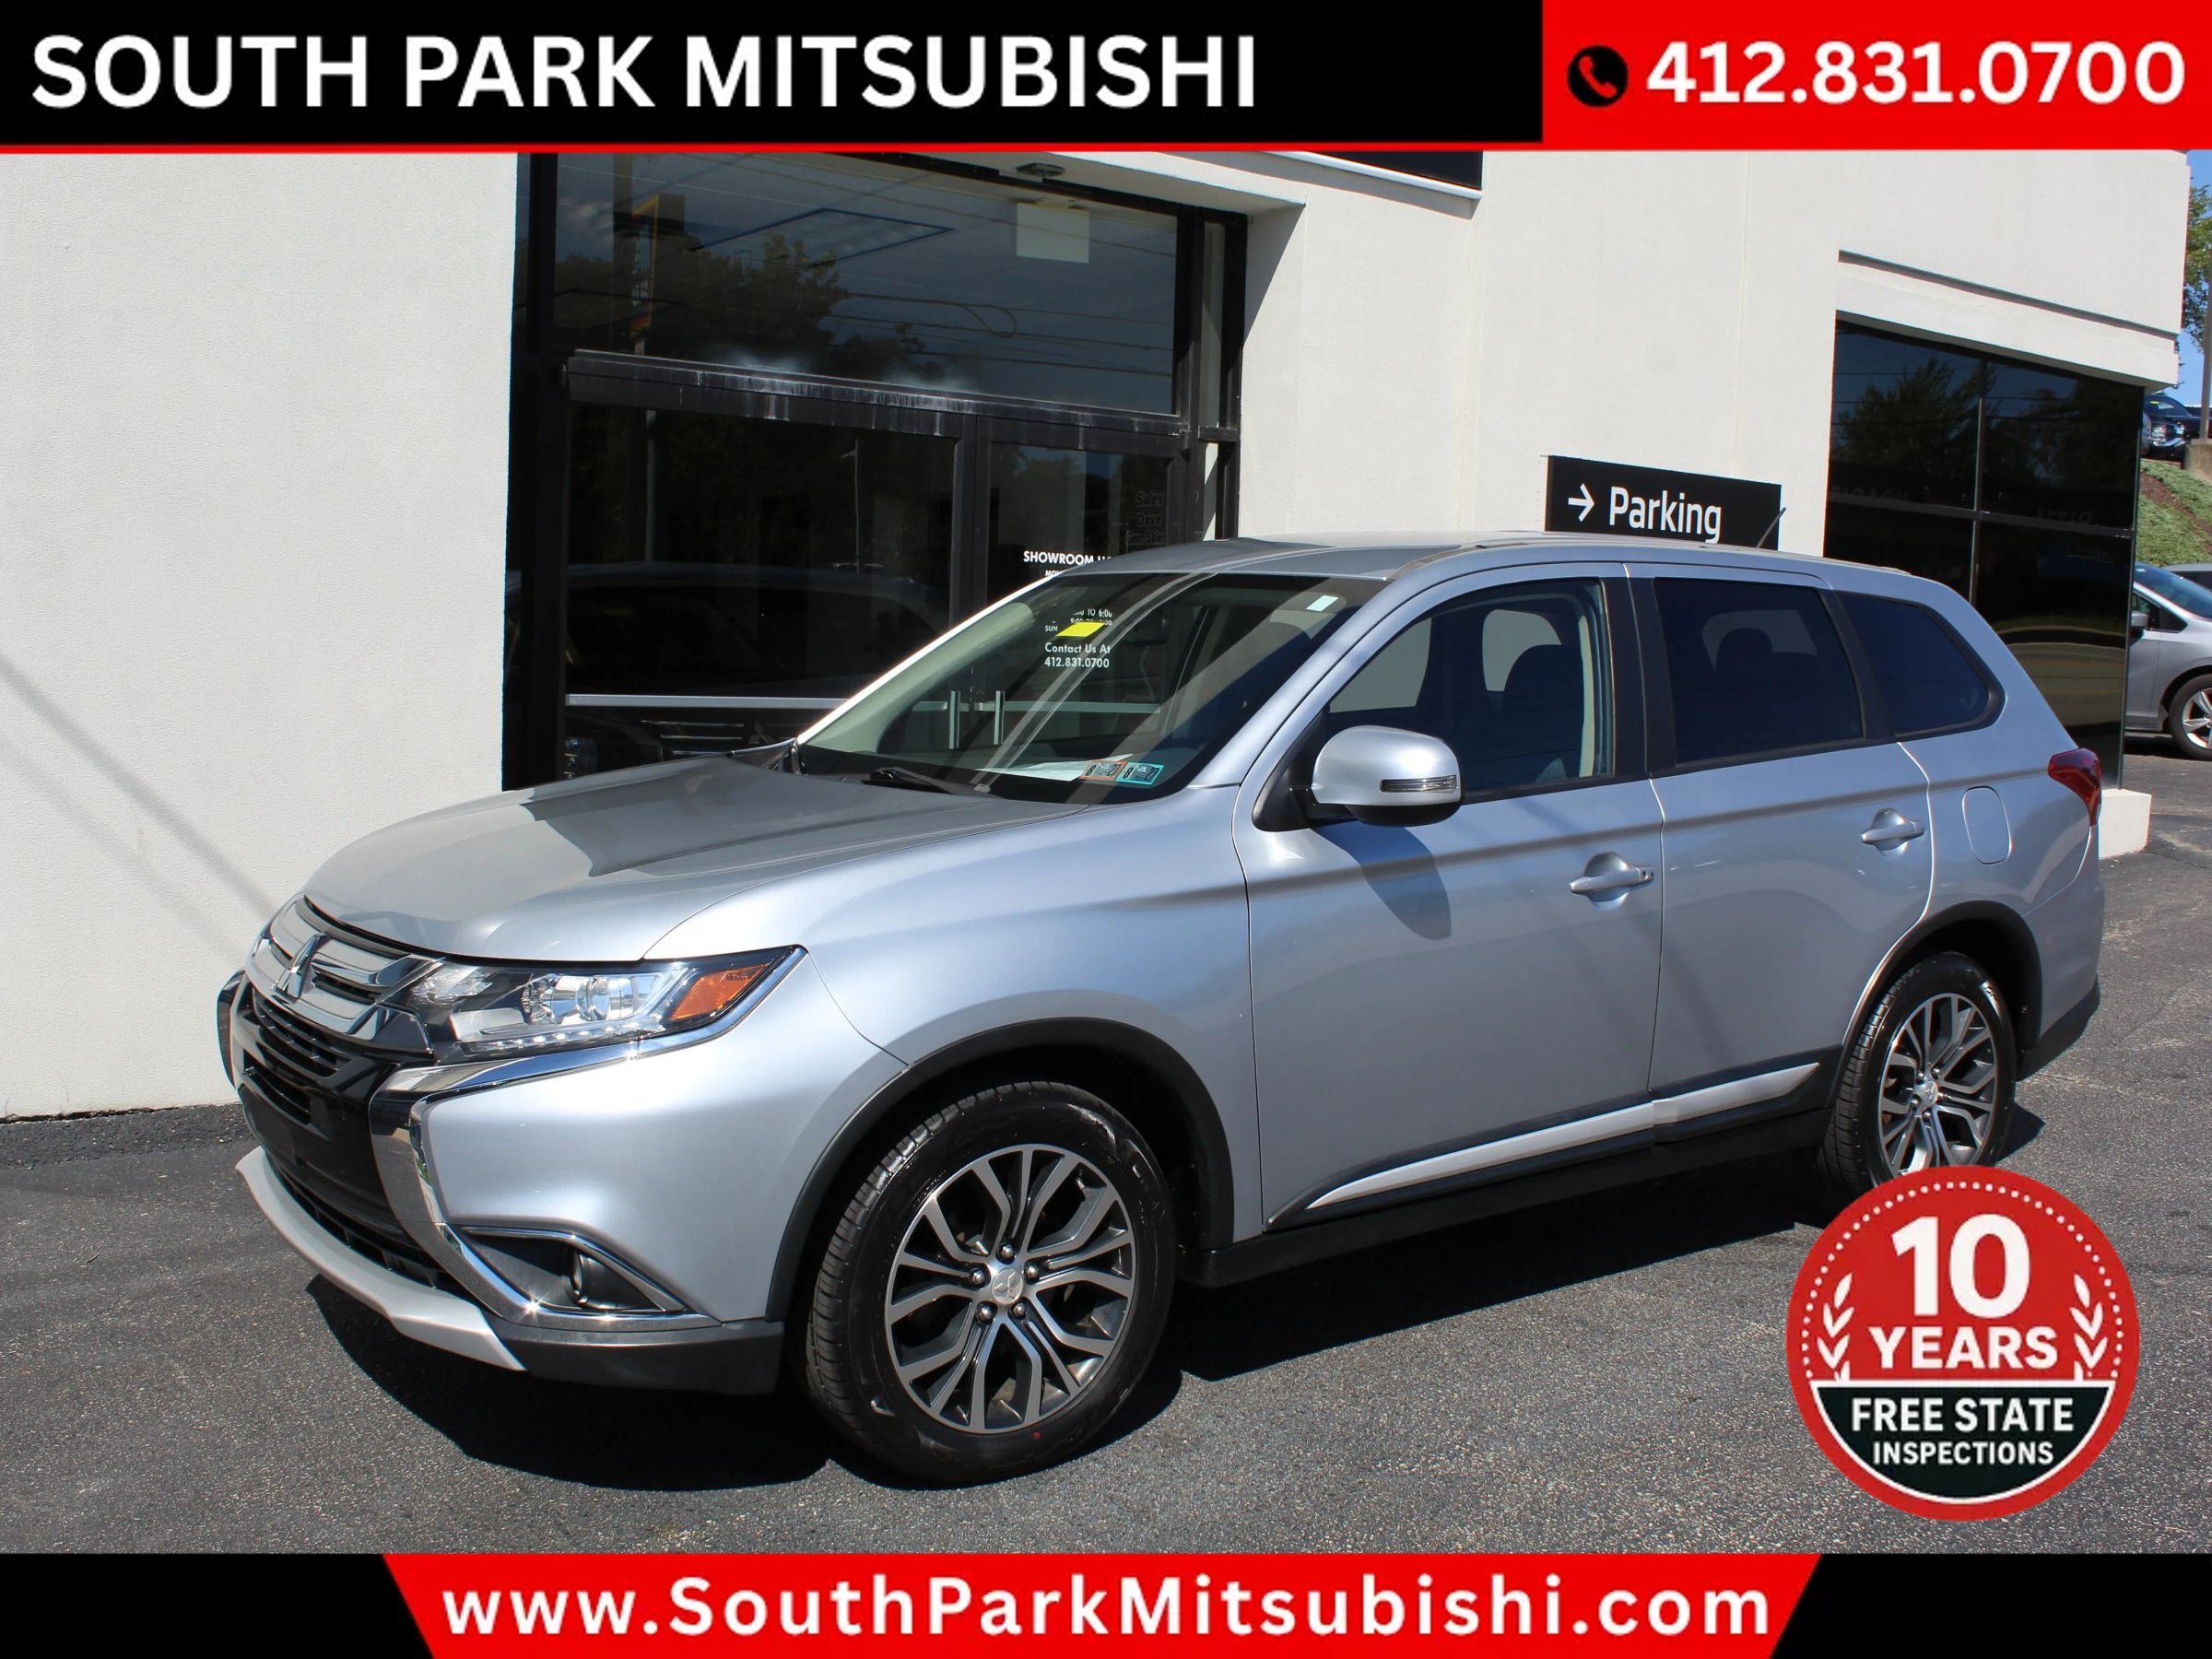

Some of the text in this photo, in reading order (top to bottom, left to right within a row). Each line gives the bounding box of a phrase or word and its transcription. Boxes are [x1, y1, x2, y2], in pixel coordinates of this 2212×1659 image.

[1608, 486, 1723, 544] Parking
[1023, 550, 1094, 565] SHOWROOM
[1044, 642, 1112, 654] Contact Us At
[1044, 656, 1110, 668] 412.831.0700
